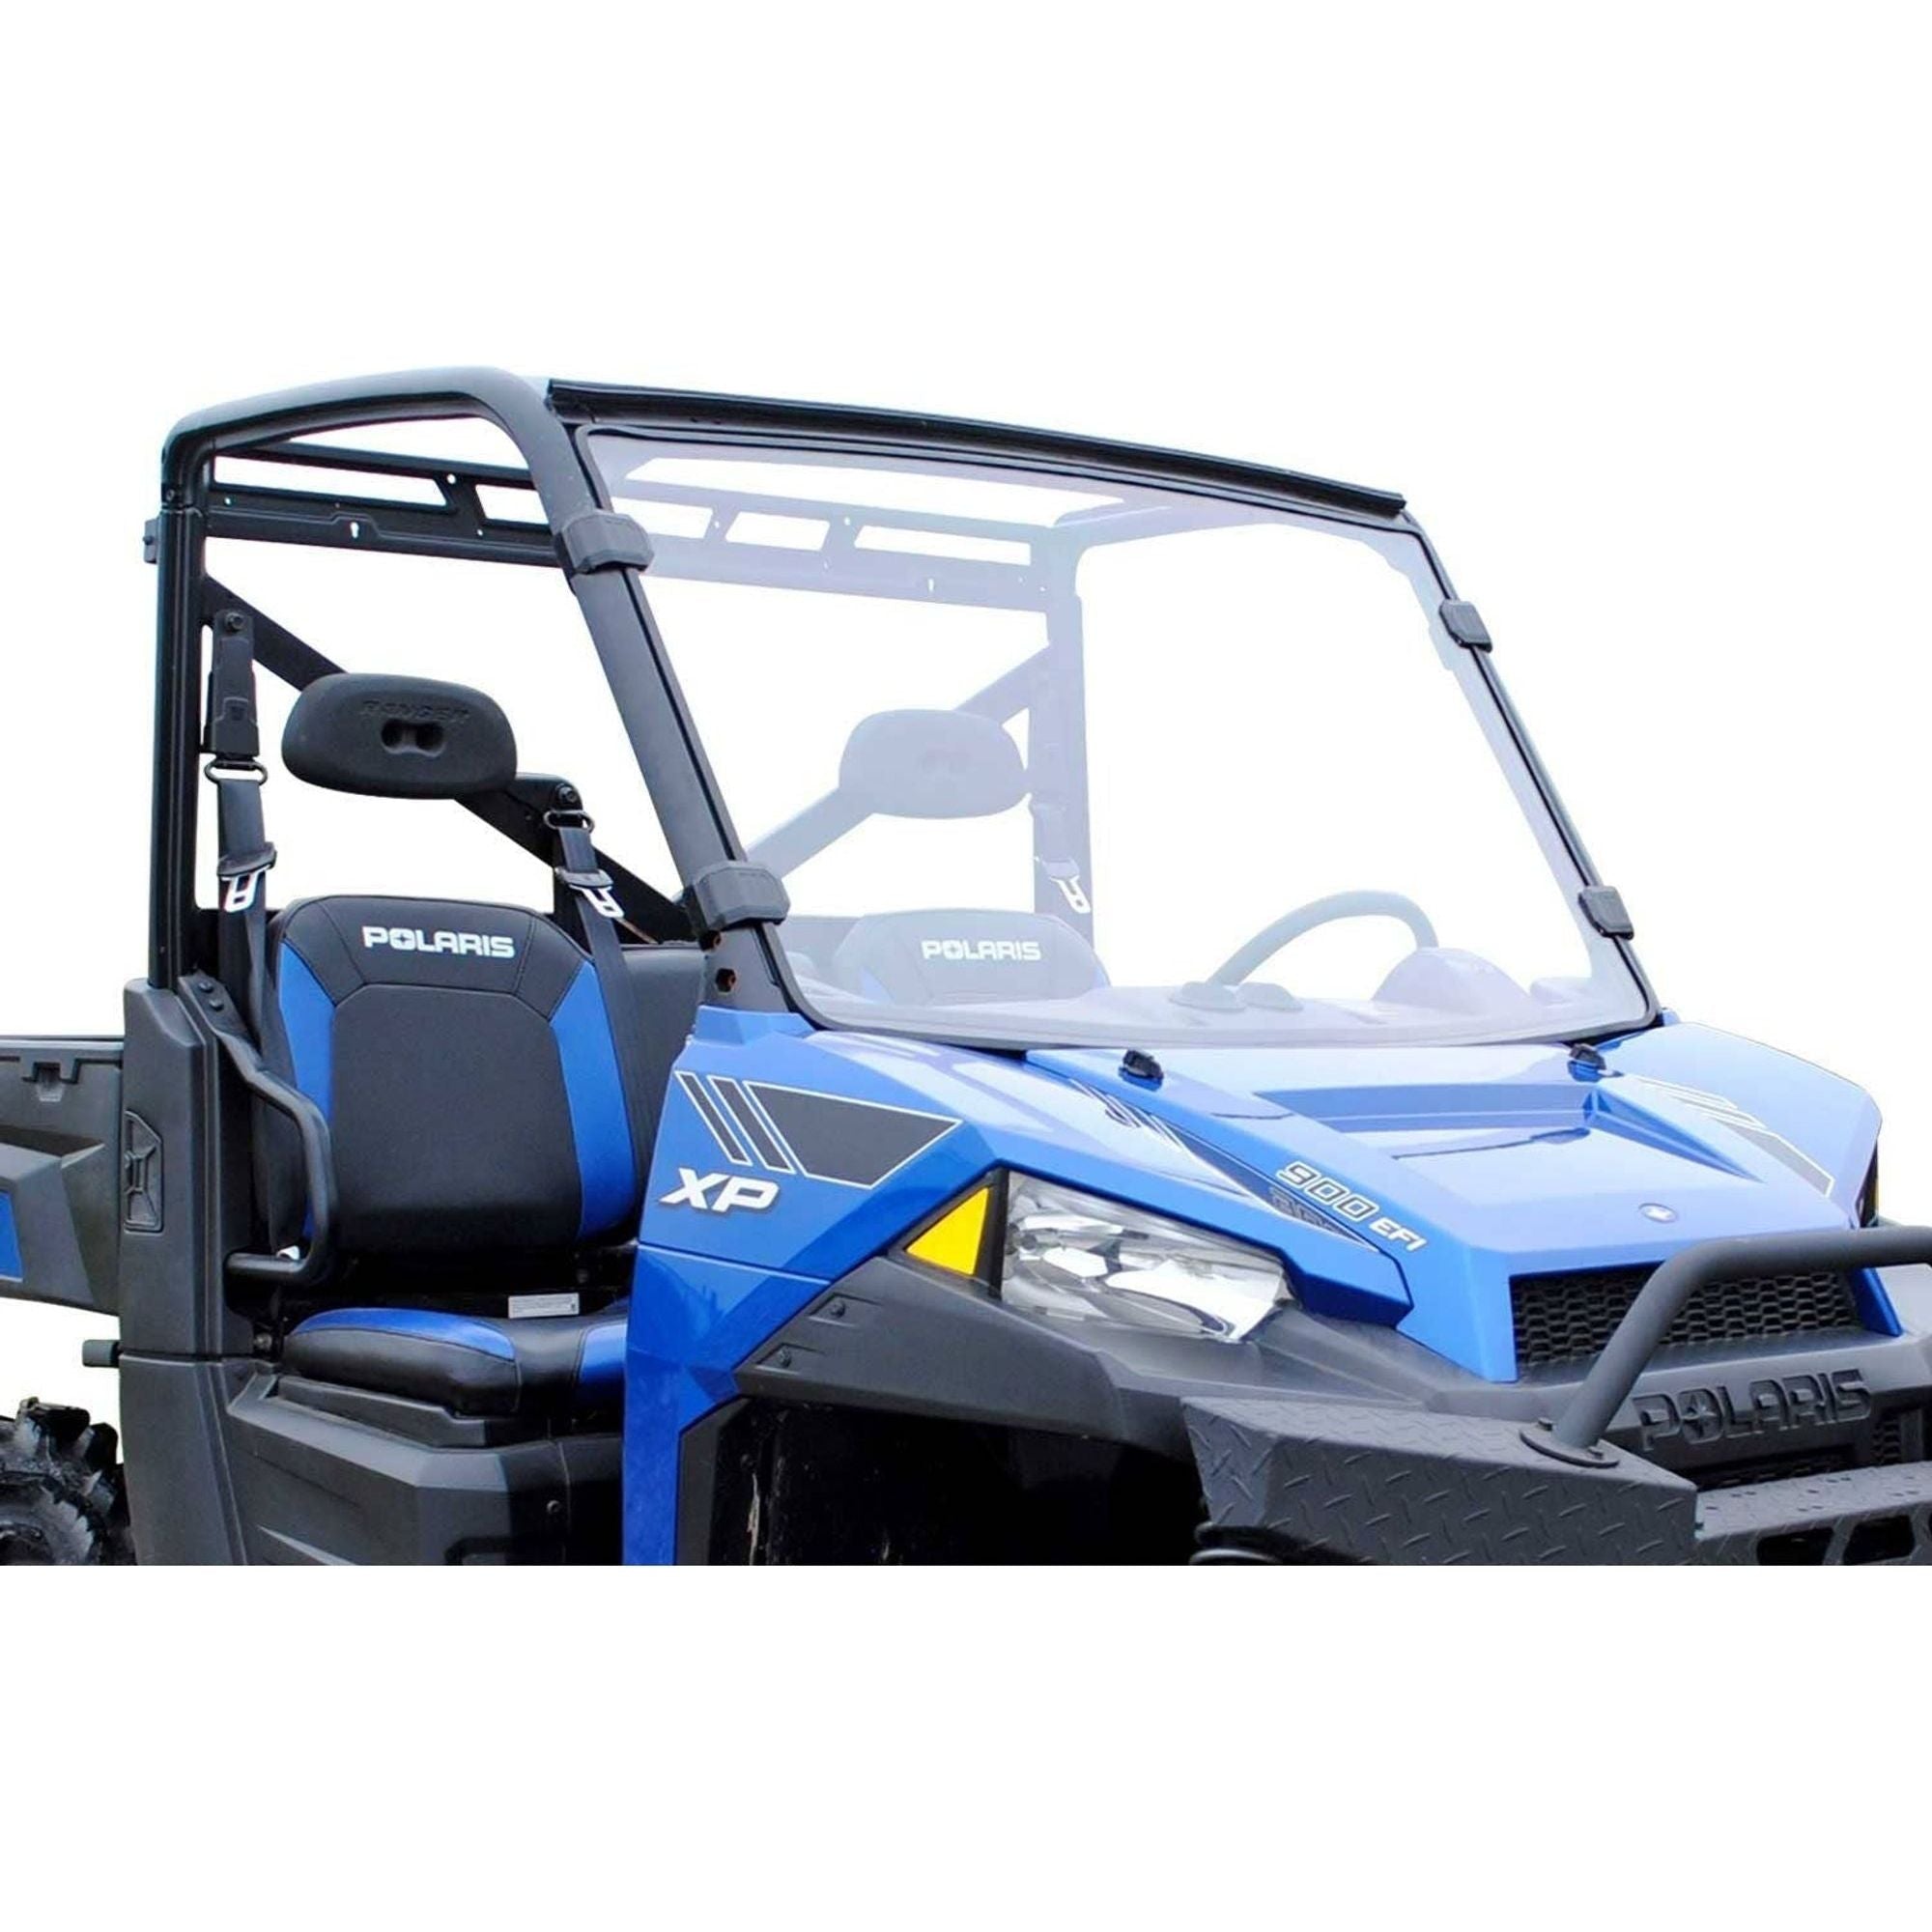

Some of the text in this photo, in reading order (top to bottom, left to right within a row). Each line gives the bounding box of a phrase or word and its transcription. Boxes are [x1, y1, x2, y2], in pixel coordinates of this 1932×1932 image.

[361, 925, 515, 958] POLARIS
[921, 939, 1041, 961] POLARIS
[659, 1167, 780, 1213] XP
[1275, 1160, 1380, 1222] 900
[1369, 1216, 1427, 1251] EFI
[1633, 1368, 1871, 1451] POLARIS
